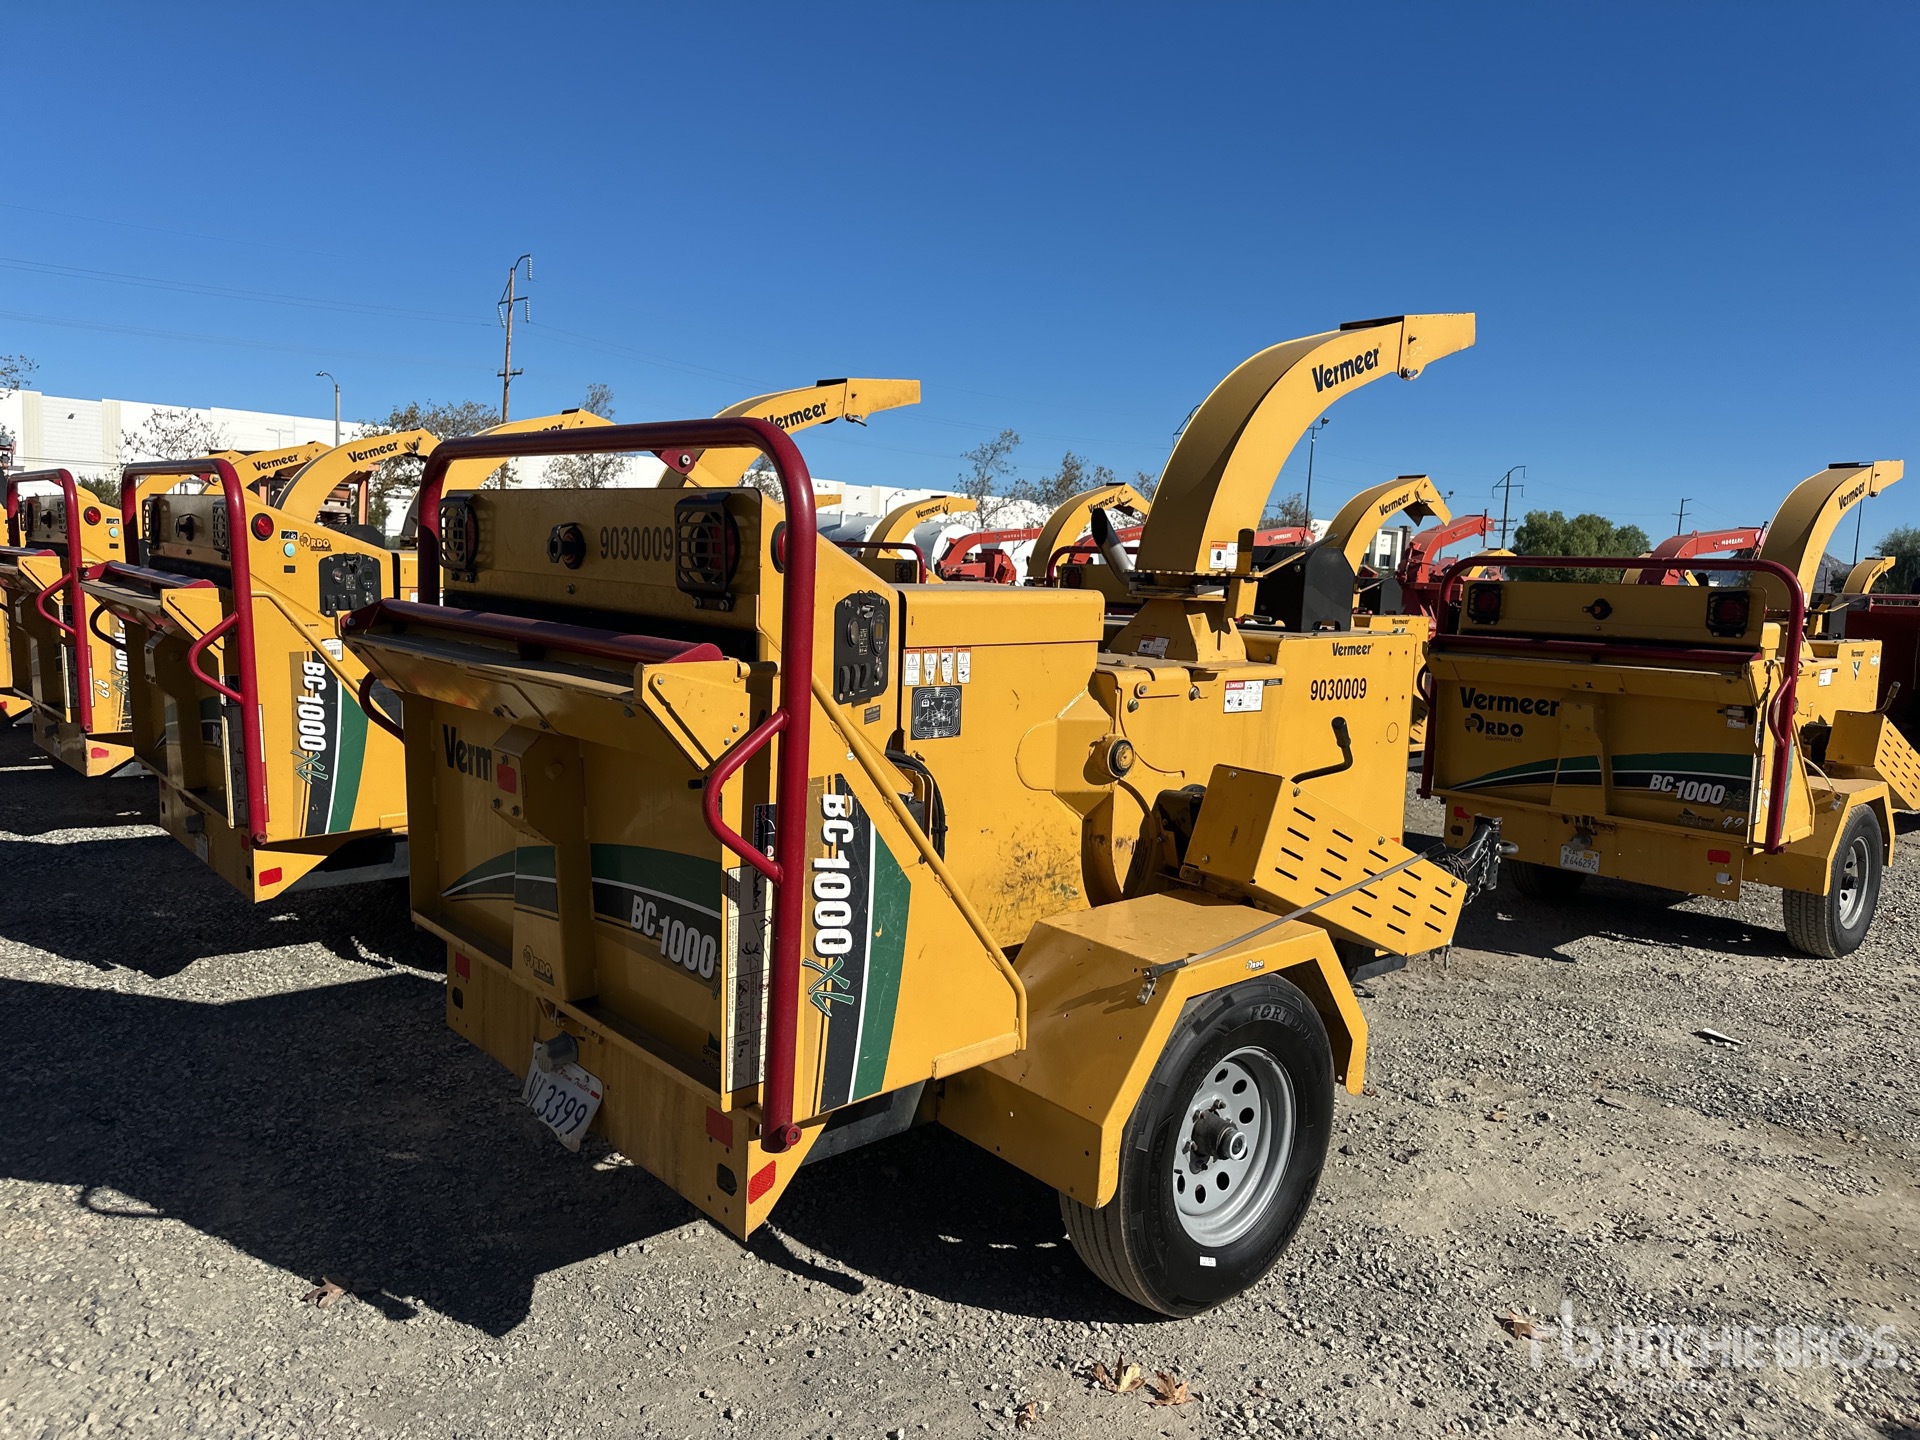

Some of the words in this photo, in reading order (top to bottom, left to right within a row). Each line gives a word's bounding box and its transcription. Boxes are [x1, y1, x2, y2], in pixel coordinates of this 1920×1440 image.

[1312, 347, 1379, 393] Vermeer
[253, 454, 298, 472] Vermeer
[347, 441, 398, 463] Vermeer
[1379, 493, 1409, 516] Vermeer
[1838, 482, 1865, 510] Vermeer
[915, 504, 941, 519] Vermeer
[600, 526, 674, 562] 9030009
[1332, 643, 1372, 657] Vermeer
[1310, 677, 1367, 701] 9030009
[1460, 686, 1560, 717] Vermeer
[443, 724, 492, 782] Verm
